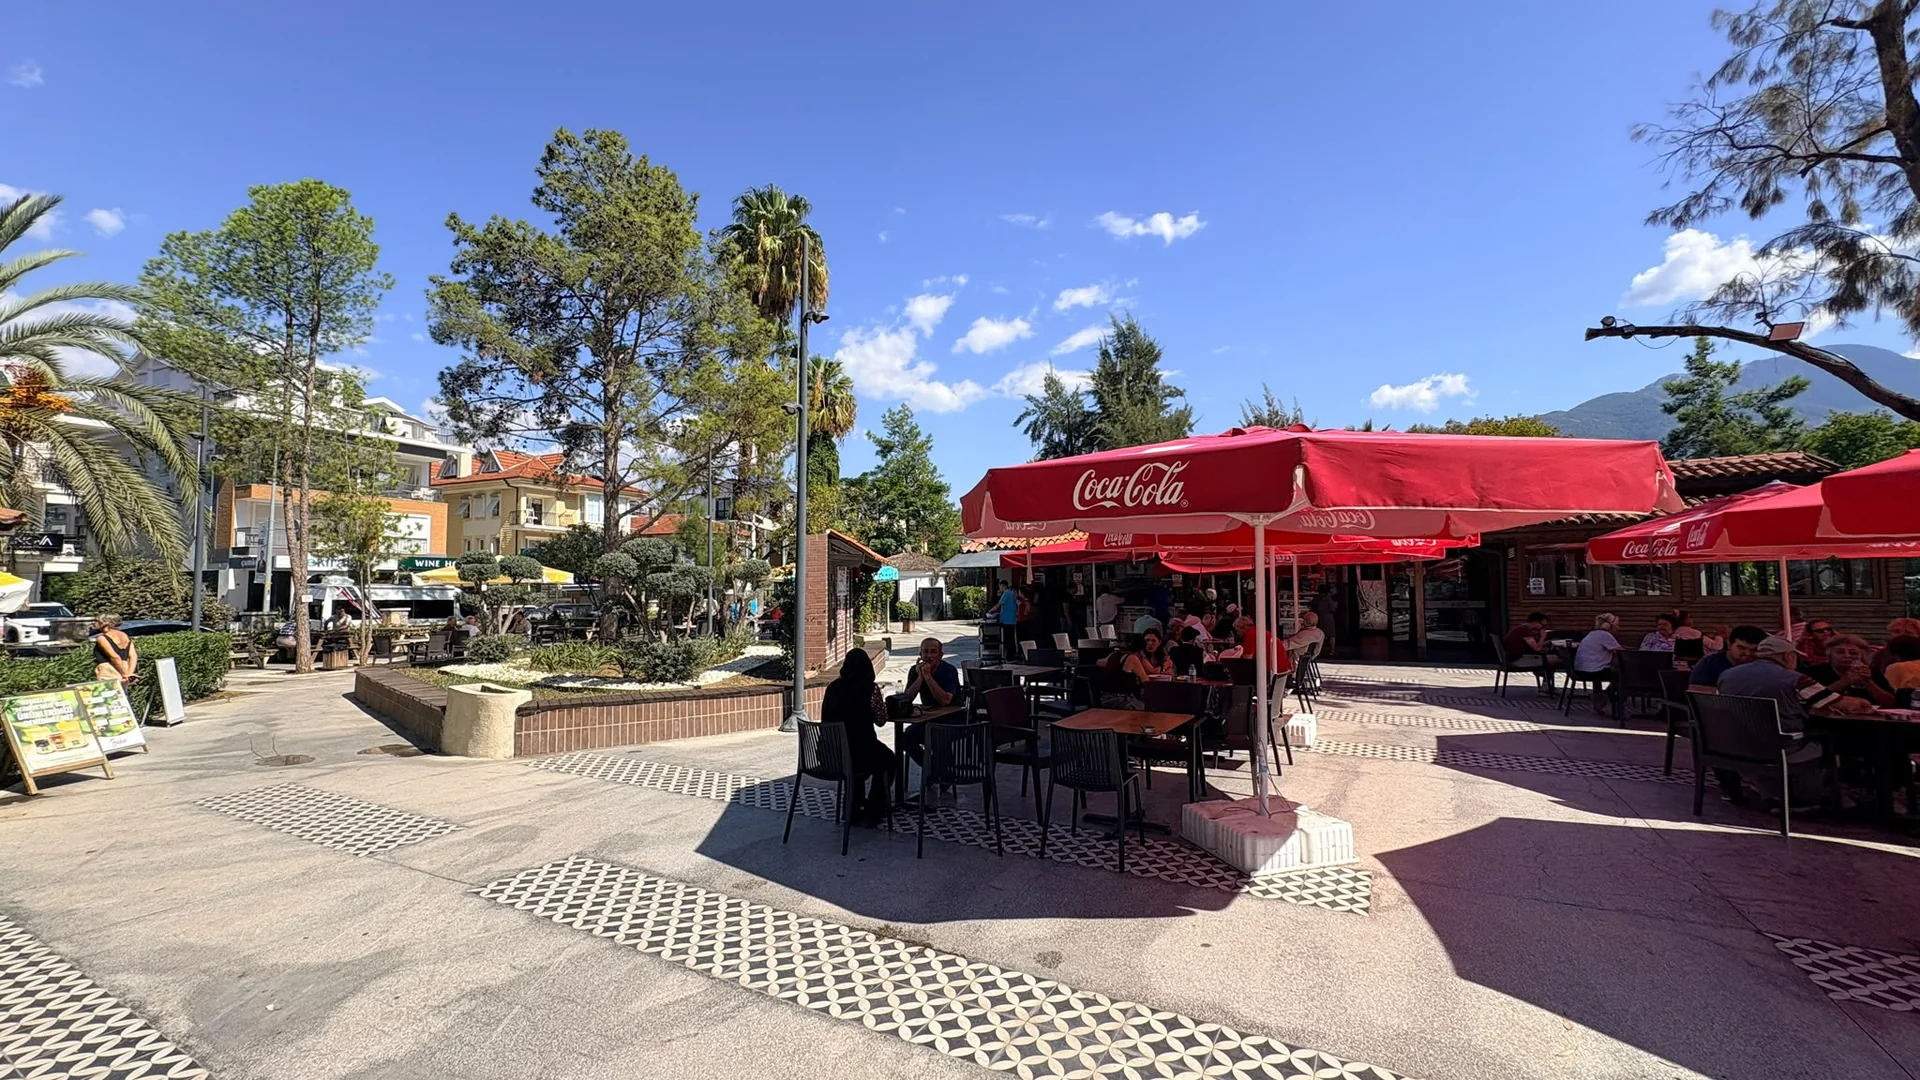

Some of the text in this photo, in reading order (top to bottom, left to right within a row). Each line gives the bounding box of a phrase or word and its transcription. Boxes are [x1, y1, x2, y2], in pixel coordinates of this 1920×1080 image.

[1073, 460, 1190, 511] Coca-Cola
[1622, 537, 1680, 559] CocaCola
[415, 560, 441, 568] WINE
